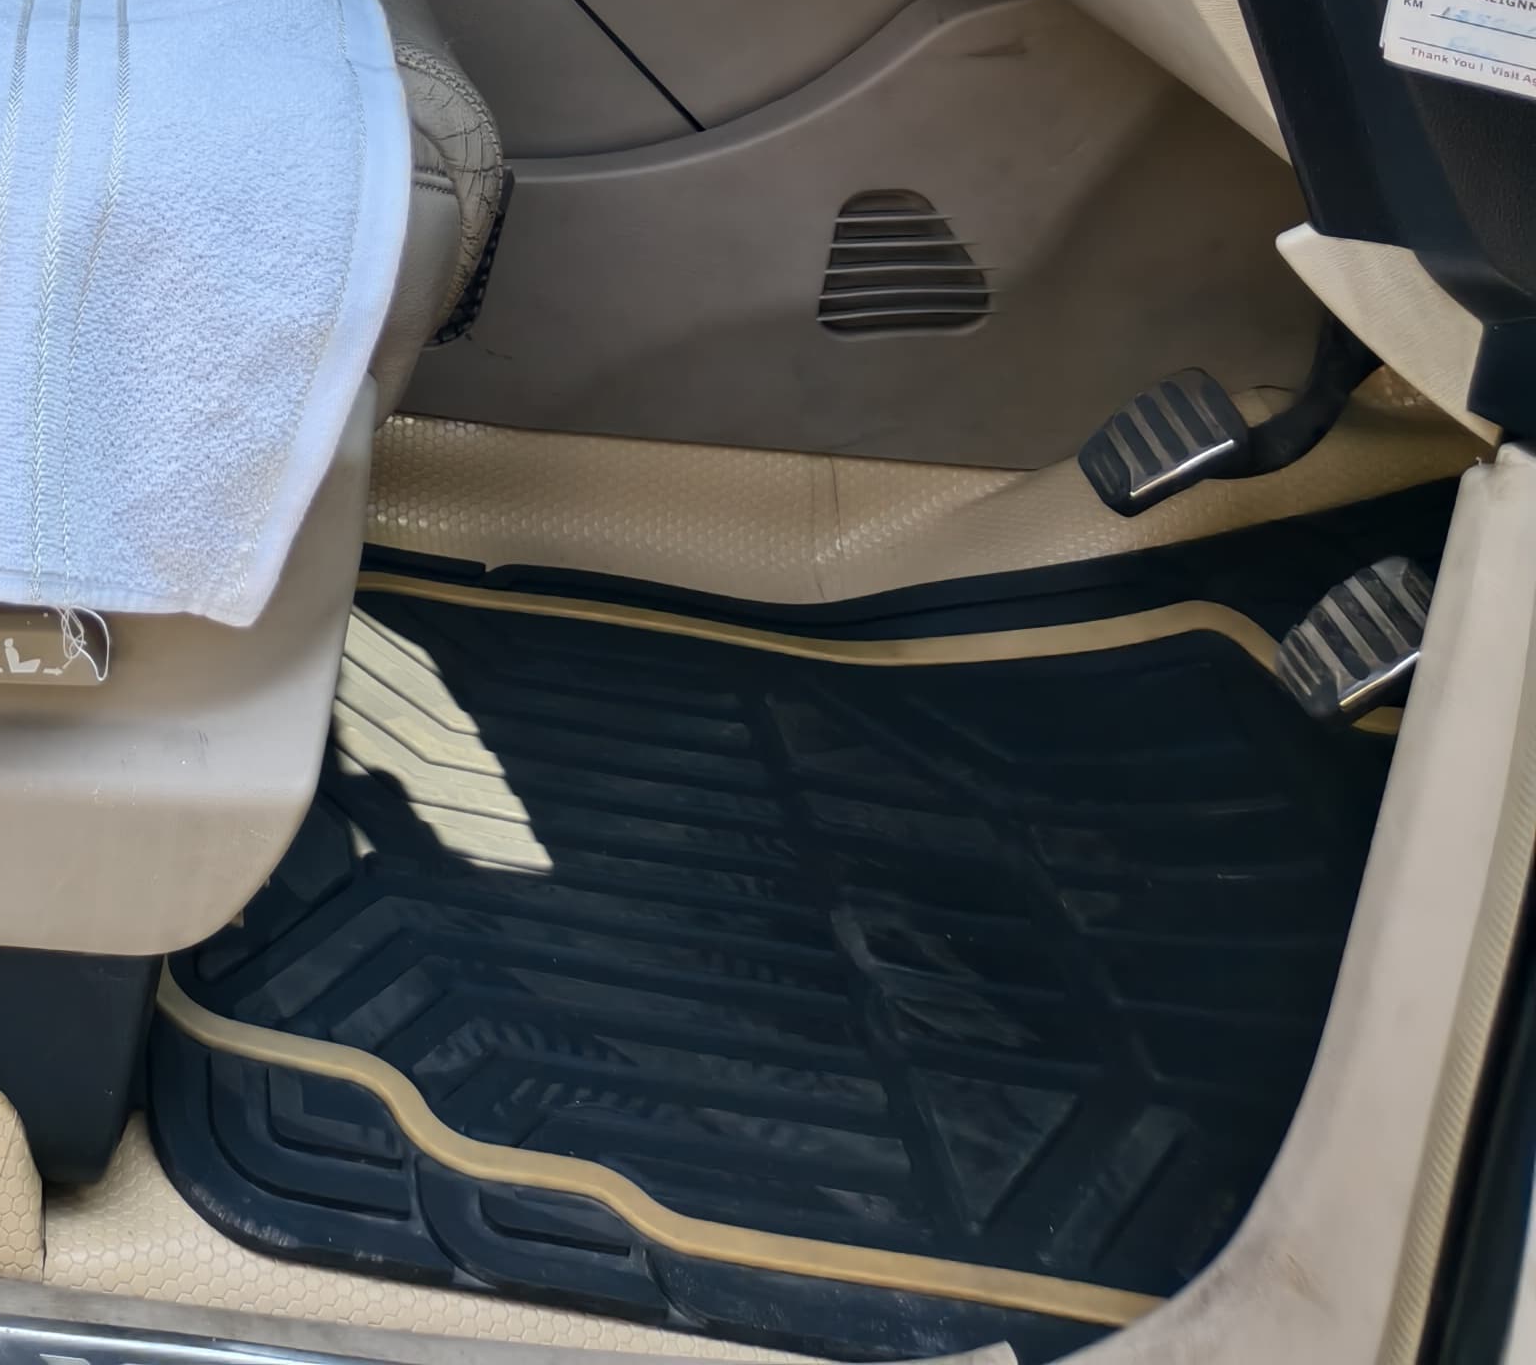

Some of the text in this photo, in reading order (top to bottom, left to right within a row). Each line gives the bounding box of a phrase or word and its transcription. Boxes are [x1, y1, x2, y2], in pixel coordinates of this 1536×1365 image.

[1410, 46, 1449, 63] Thank
[1452, 57, 1476, 70] You
[1491, 65, 1520, 81] Visit
